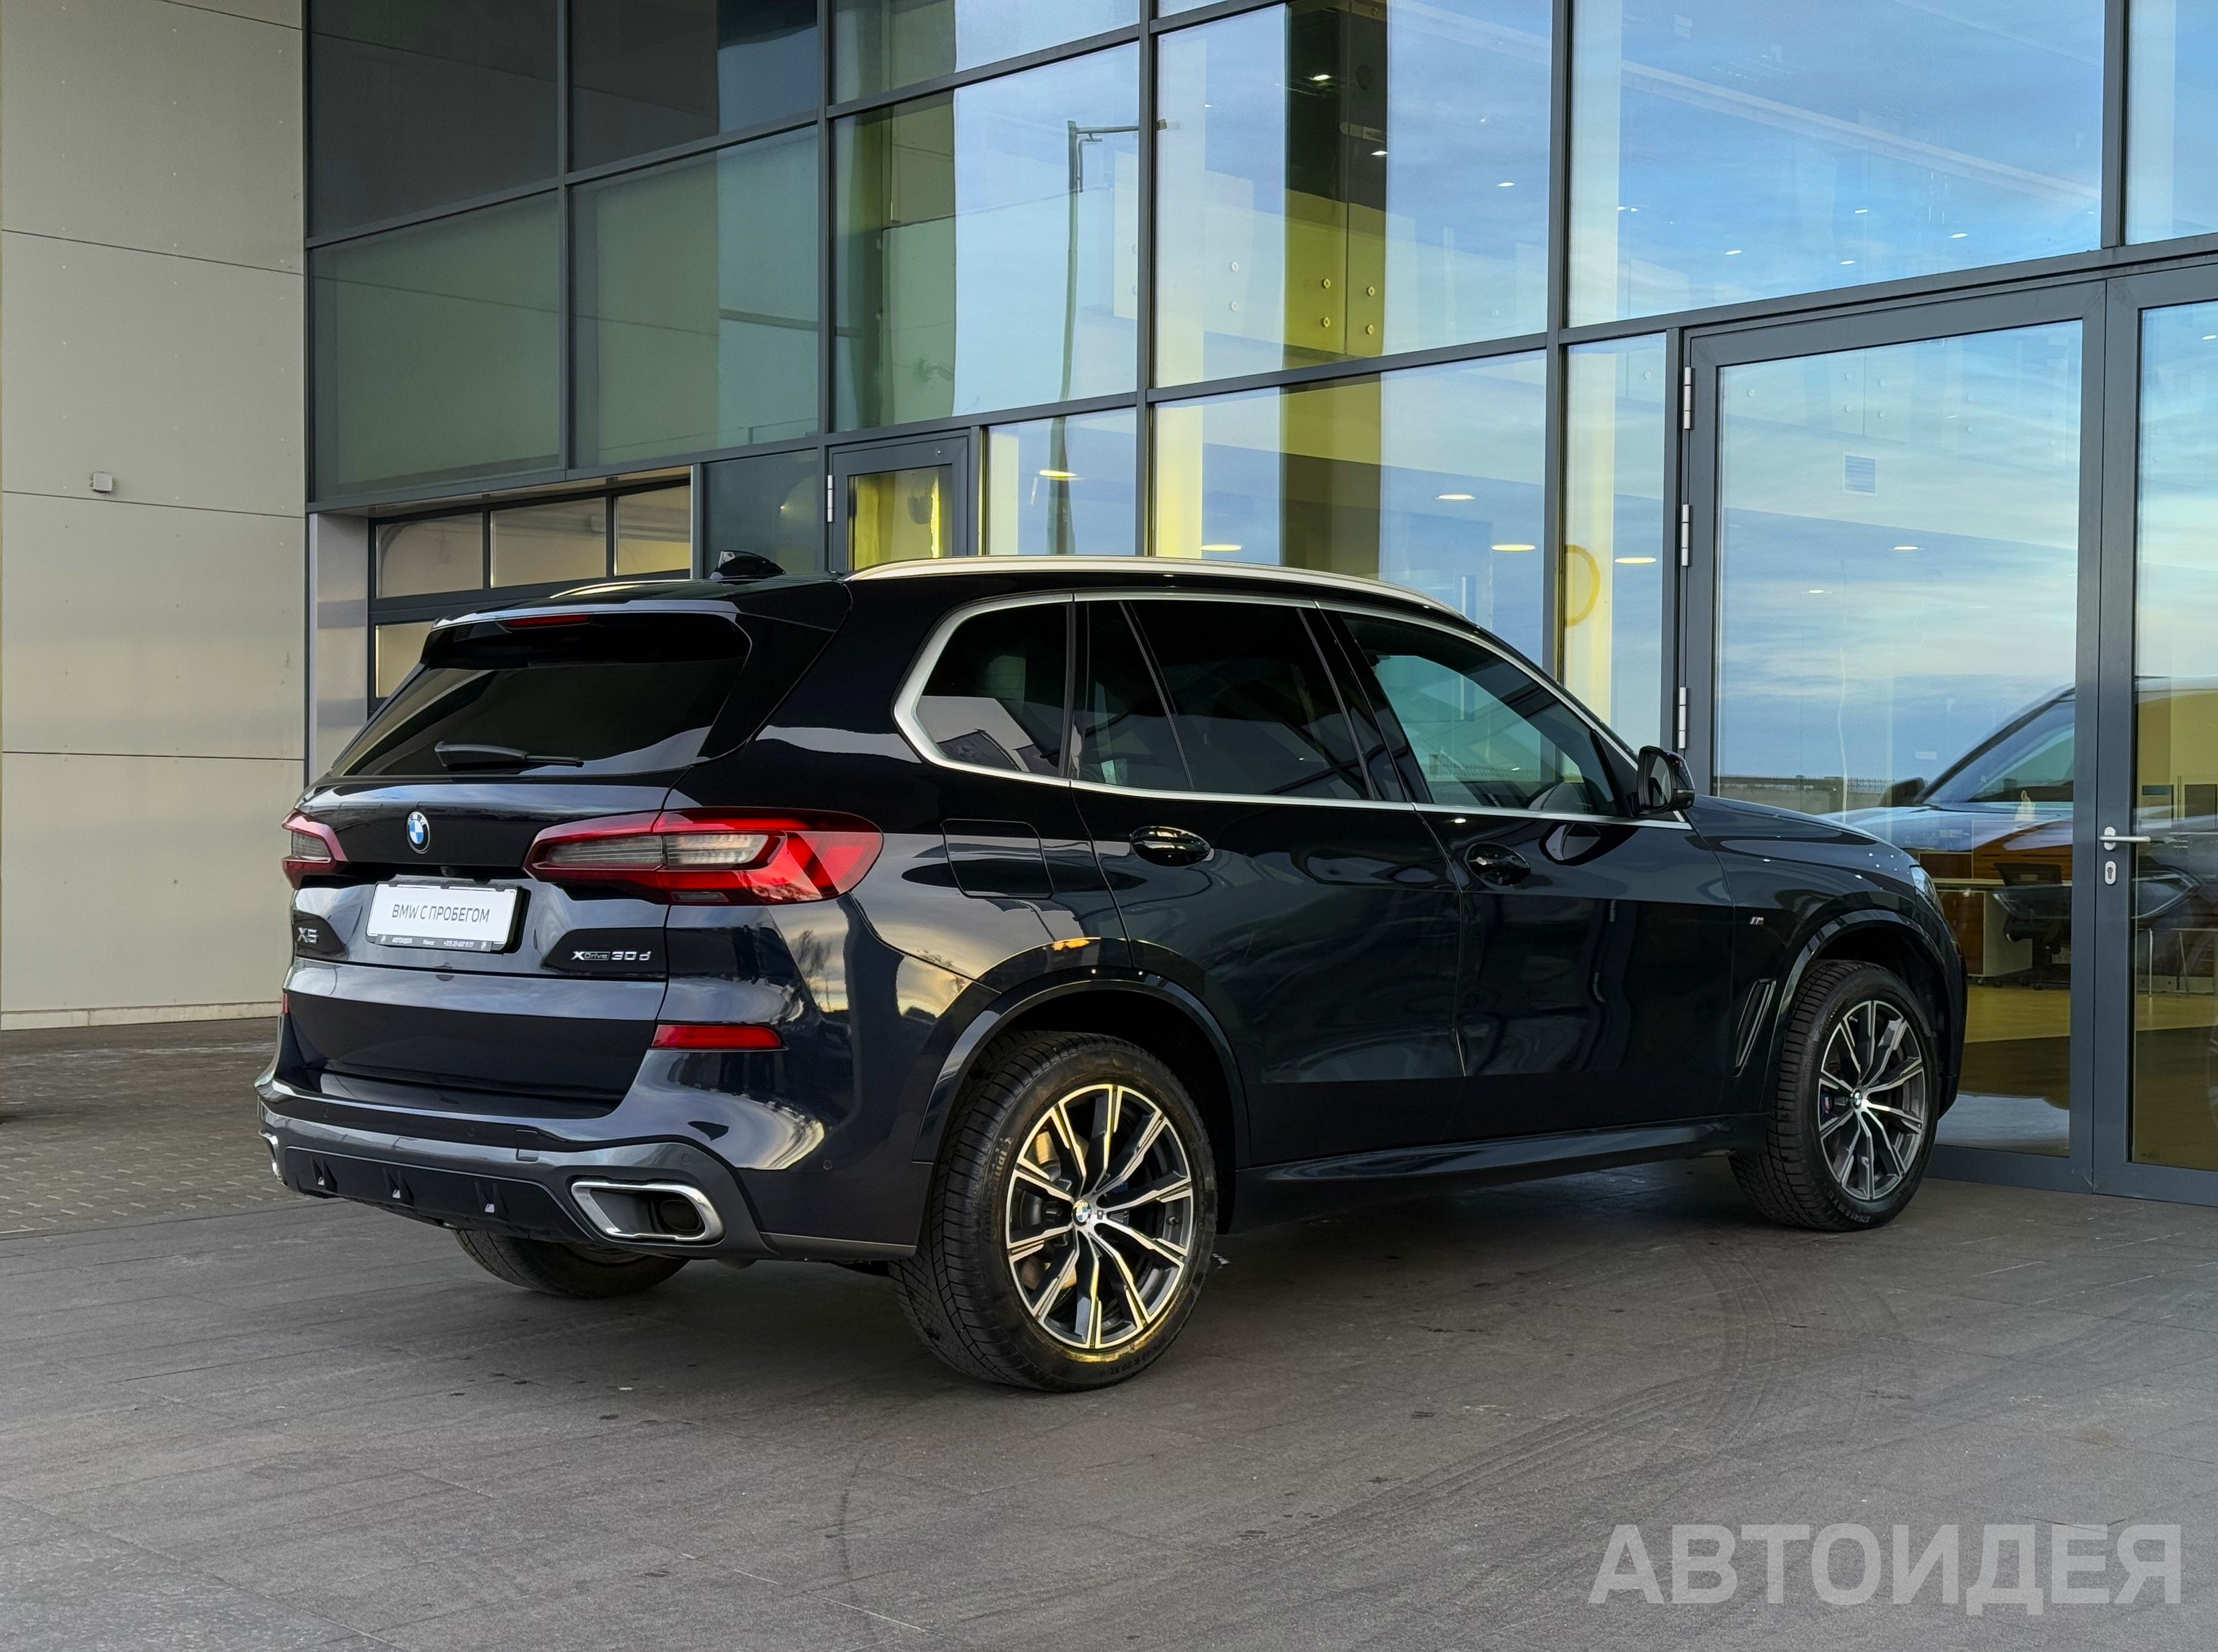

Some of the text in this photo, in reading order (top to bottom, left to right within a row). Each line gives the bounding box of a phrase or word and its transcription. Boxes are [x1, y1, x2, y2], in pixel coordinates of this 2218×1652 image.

[391, 904, 491, 923] BMW С ПРОБЕГОМ
[297, 927, 318, 944] X5
